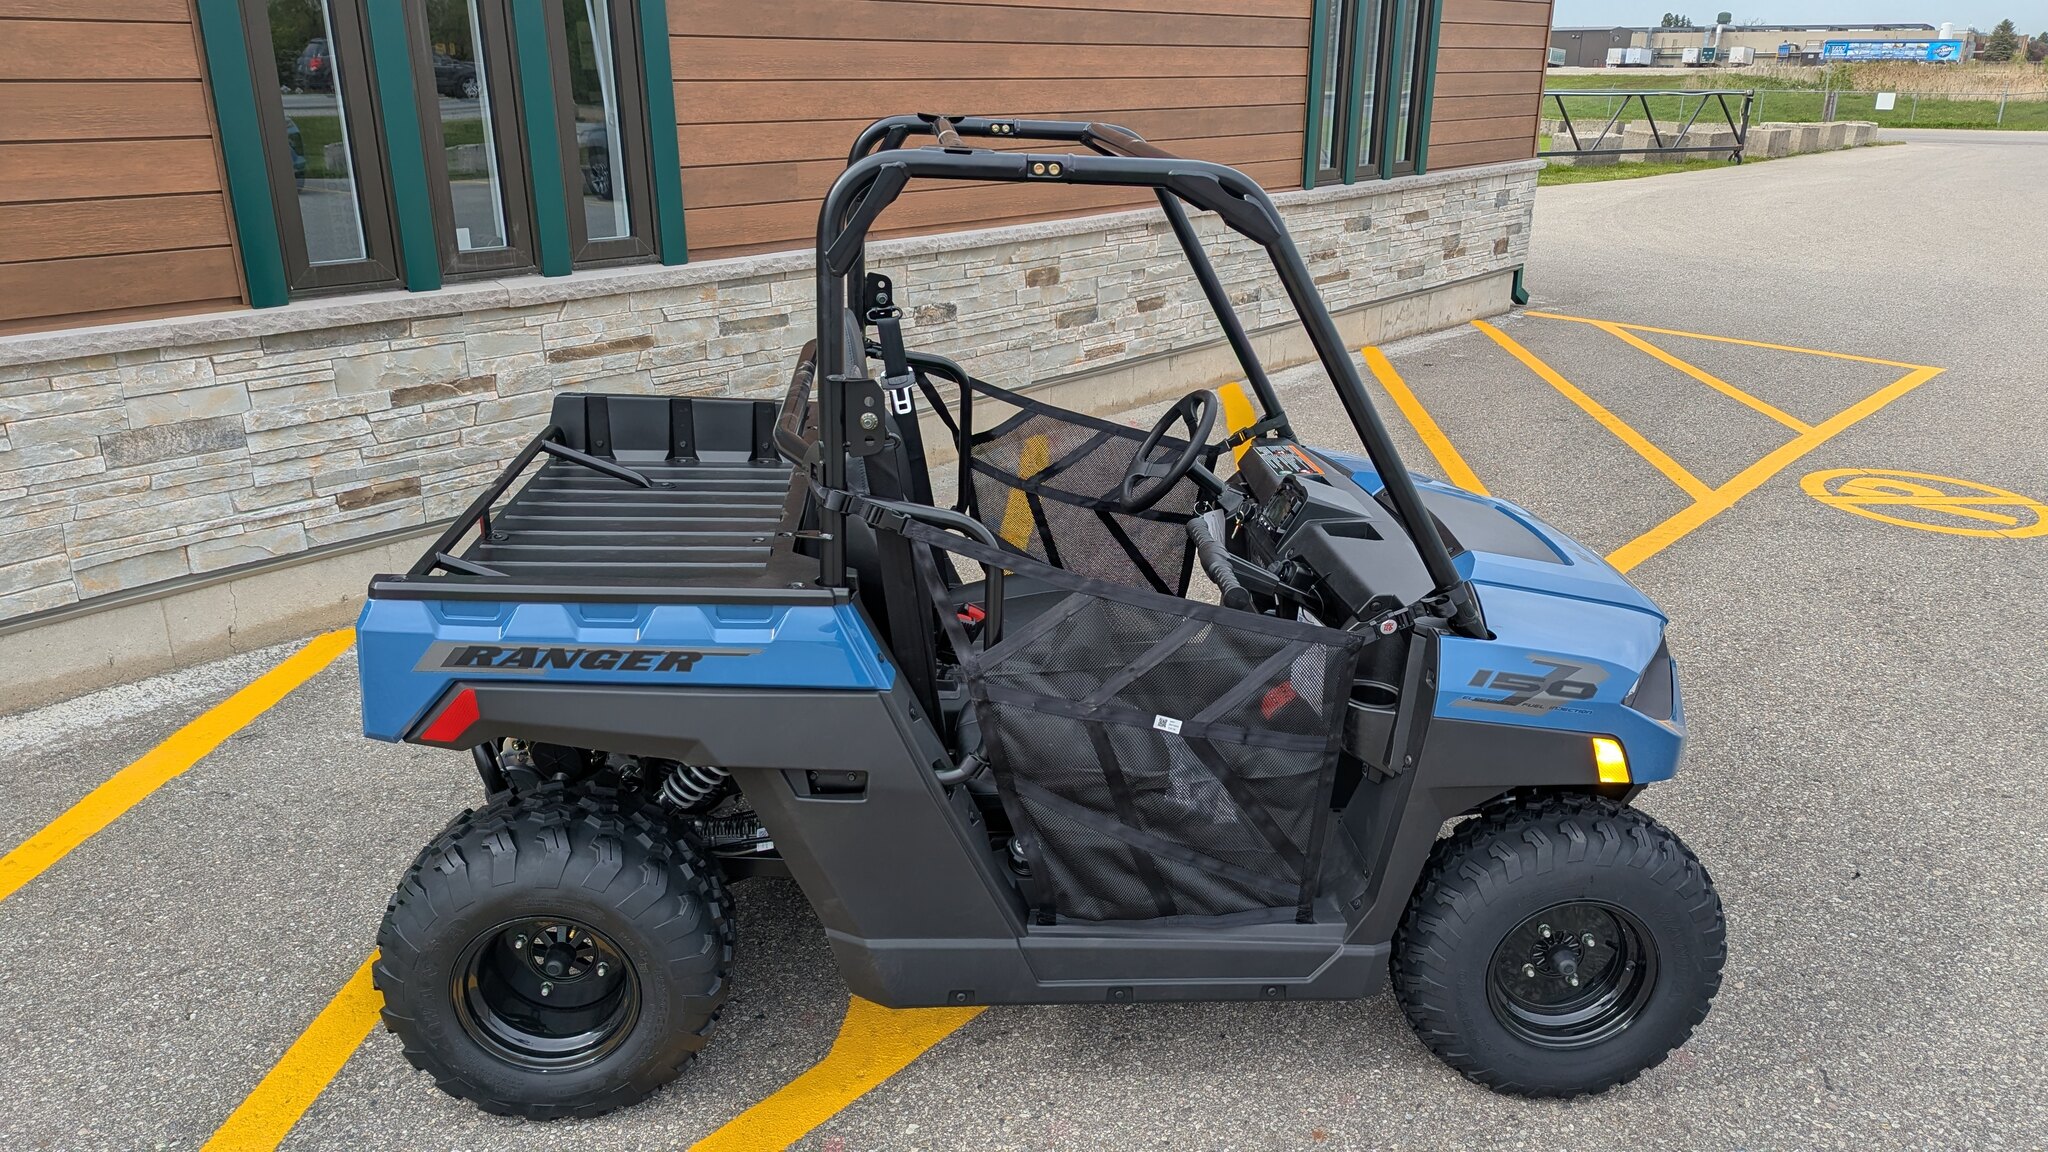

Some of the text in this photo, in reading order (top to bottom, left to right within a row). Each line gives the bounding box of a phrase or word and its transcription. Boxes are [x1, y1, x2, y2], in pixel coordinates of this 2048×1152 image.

[455, 645, 704, 673] RANGER
[1468, 666, 1599, 703] 150
[1522, 702, 1545, 710] FUEL
